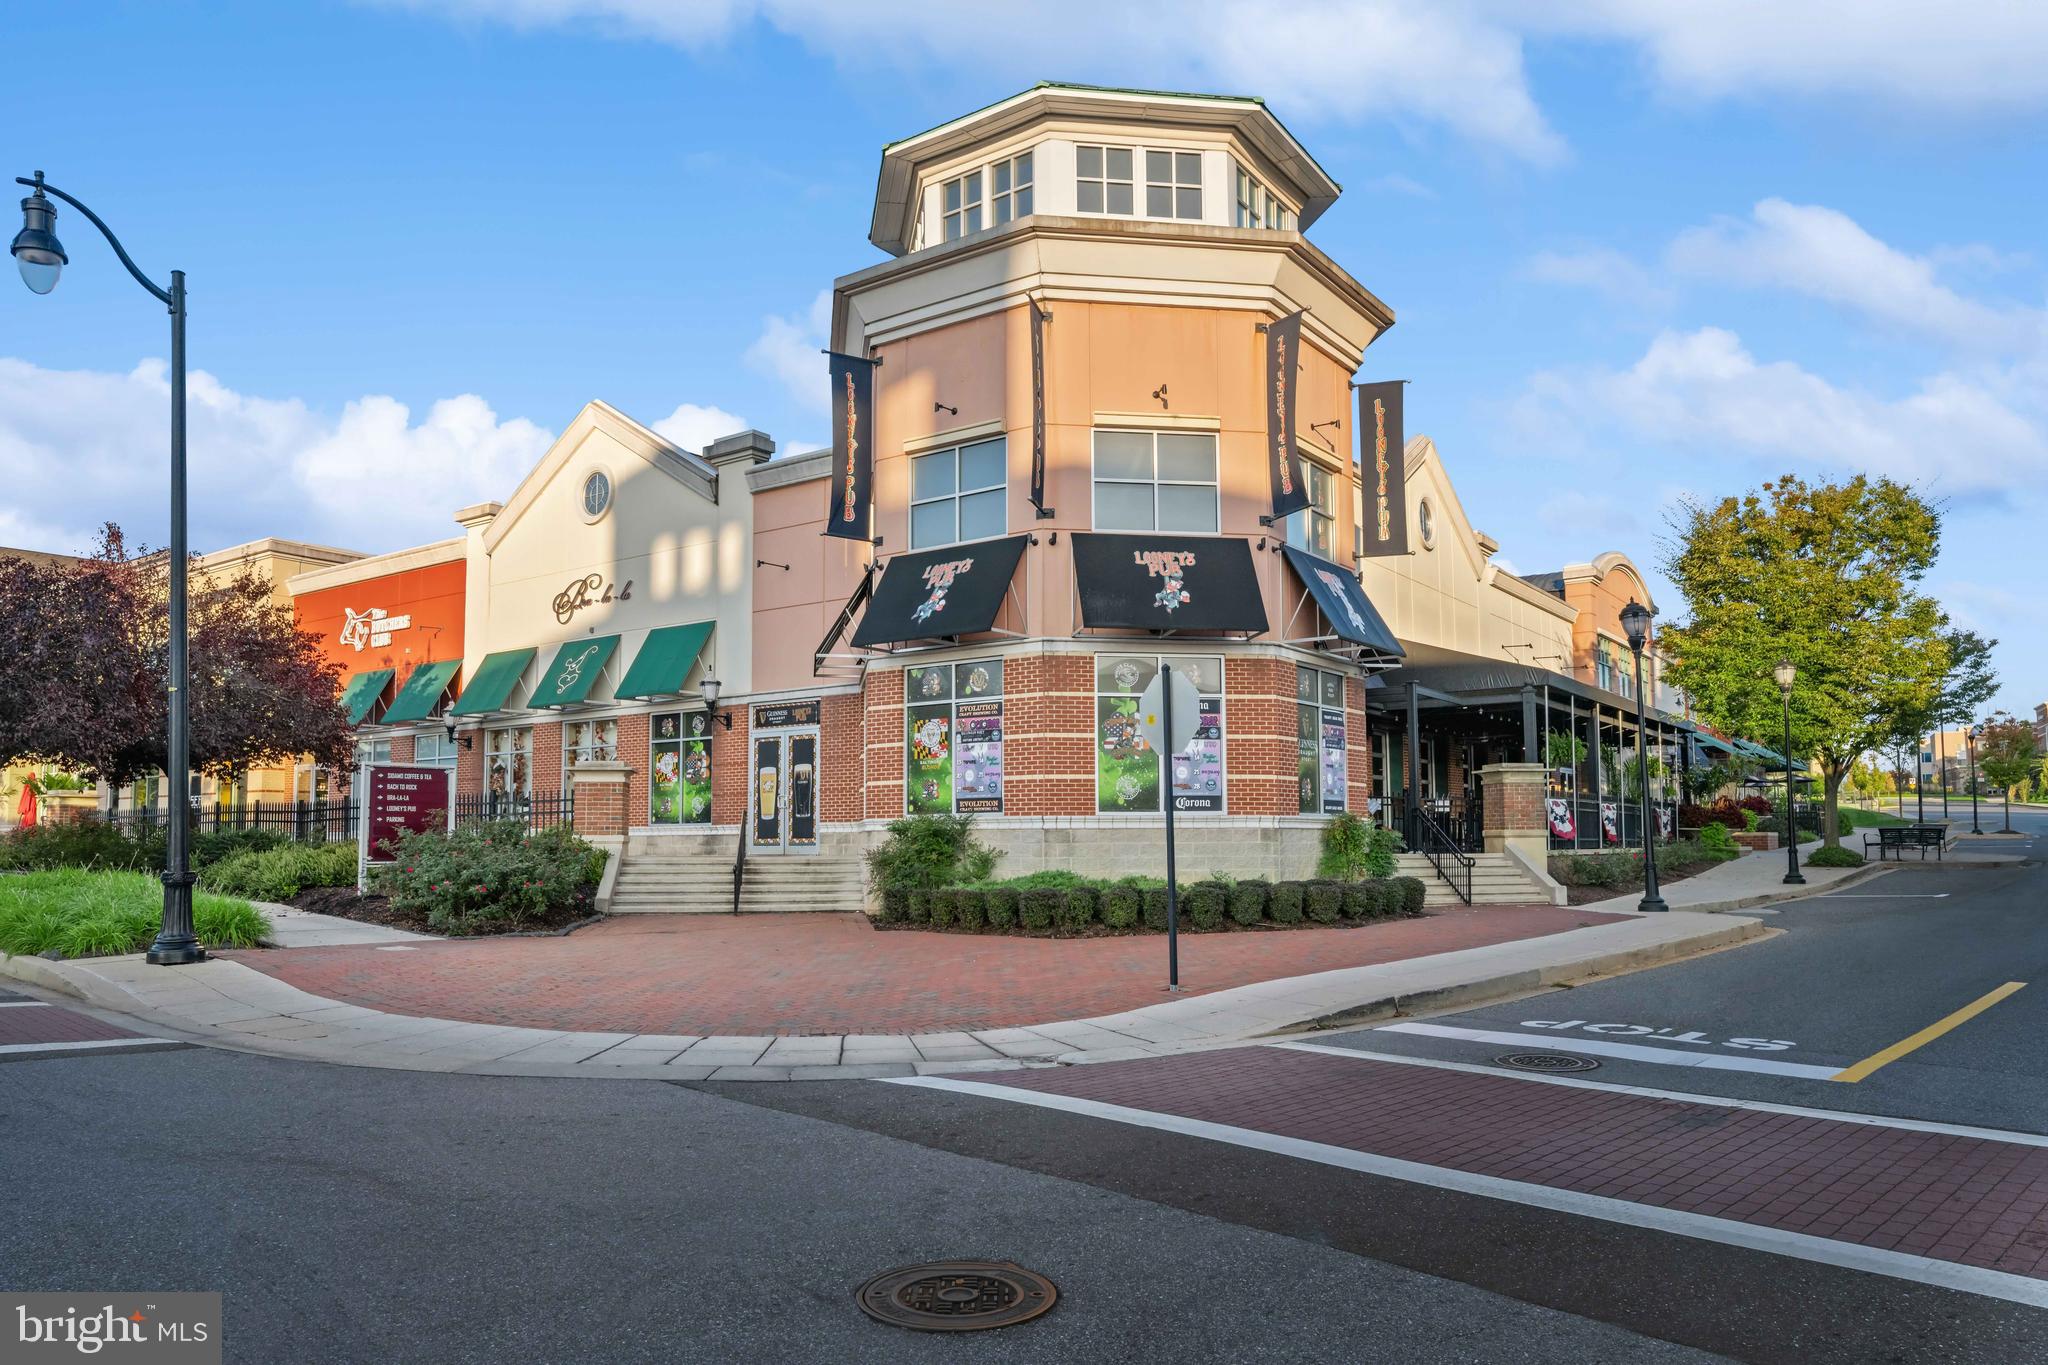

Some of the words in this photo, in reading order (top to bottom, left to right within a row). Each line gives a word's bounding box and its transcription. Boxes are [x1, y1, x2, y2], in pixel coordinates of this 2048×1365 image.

[1134, 551, 1196, 566] LOONEY'S
[1149, 562, 1183, 577] PUB
[959, 704, 999, 712] EVOLUTION
[1175, 797, 1211, 810] Corona
[1520, 1020, 1797, 1051] STOP
